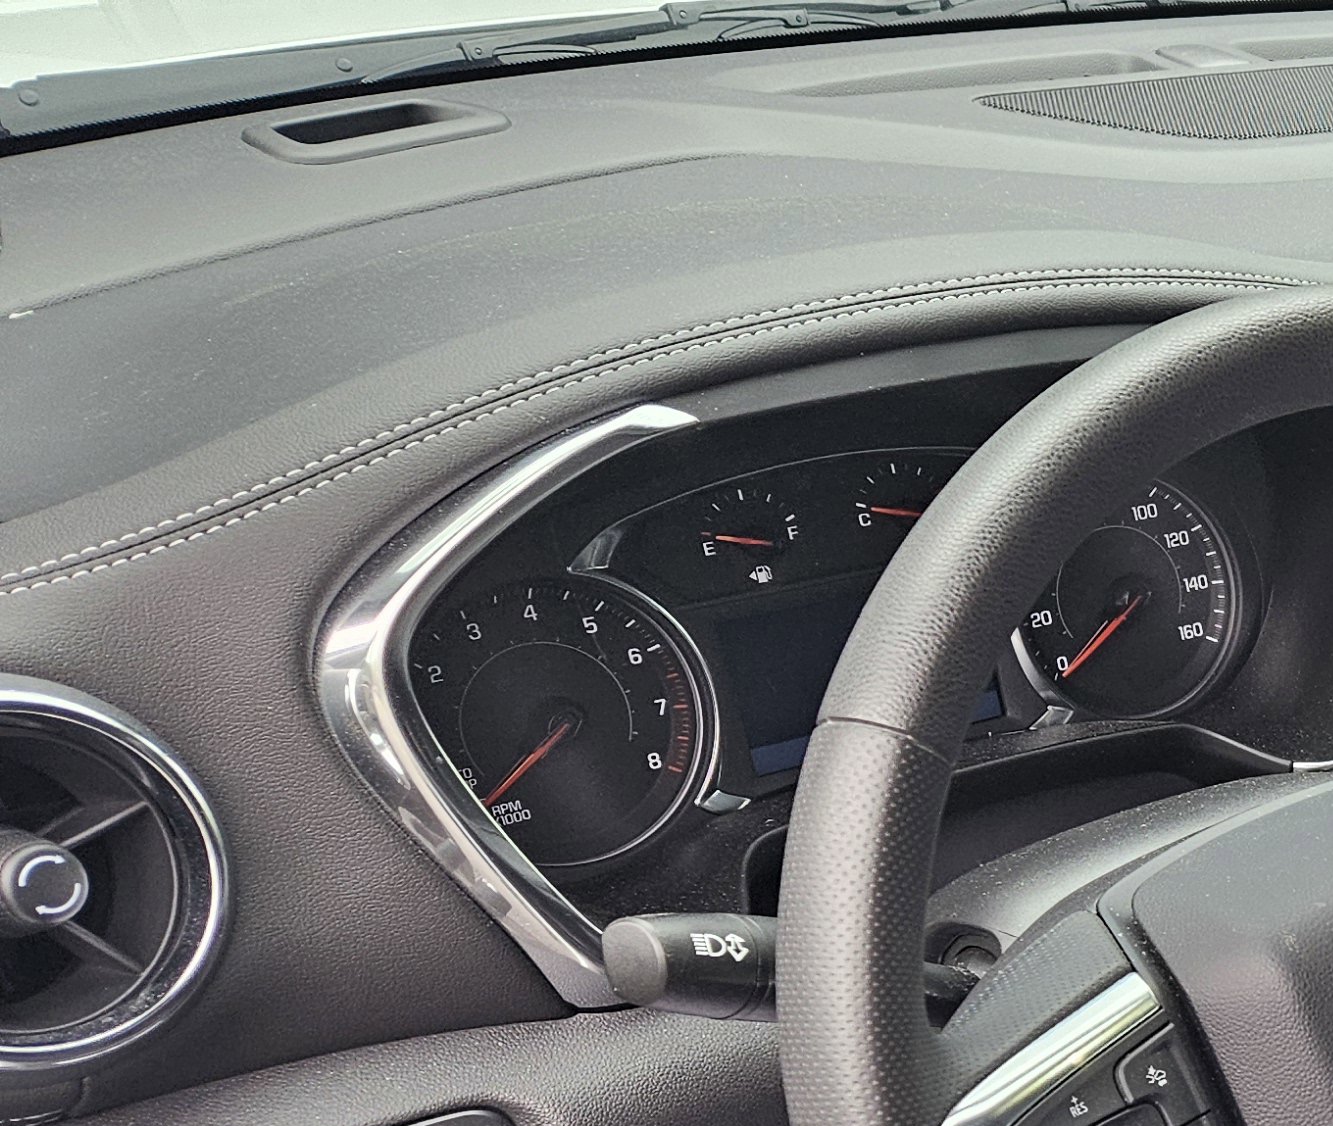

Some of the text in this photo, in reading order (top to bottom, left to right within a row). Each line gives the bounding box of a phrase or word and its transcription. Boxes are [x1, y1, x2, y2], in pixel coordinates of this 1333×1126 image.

[857, 513, 872, 527] C
[1131, 503, 1159, 521] 100
[786, 524, 799, 541] F
[1164, 530, 1190, 548] 120
[702, 541, 717, 557] E
[1183, 574, 1209, 592] 140
[523, 604, 538, 621] 4
[1030, 610, 1053, 629] 20
[466, 623, 482, 641] 3
[583, 616, 599, 634] 5
[1177, 622, 1204, 641] 160
[627, 647, 643, 665] 6
[1056, 656, 1069, 672] 0
[427, 665, 444, 683] 2
[653, 699, 667, 716] 7
[647, 753, 662, 770] 8
[491, 800, 523, 816] RPM
[1070, 1102, 1088, 1118] RES
